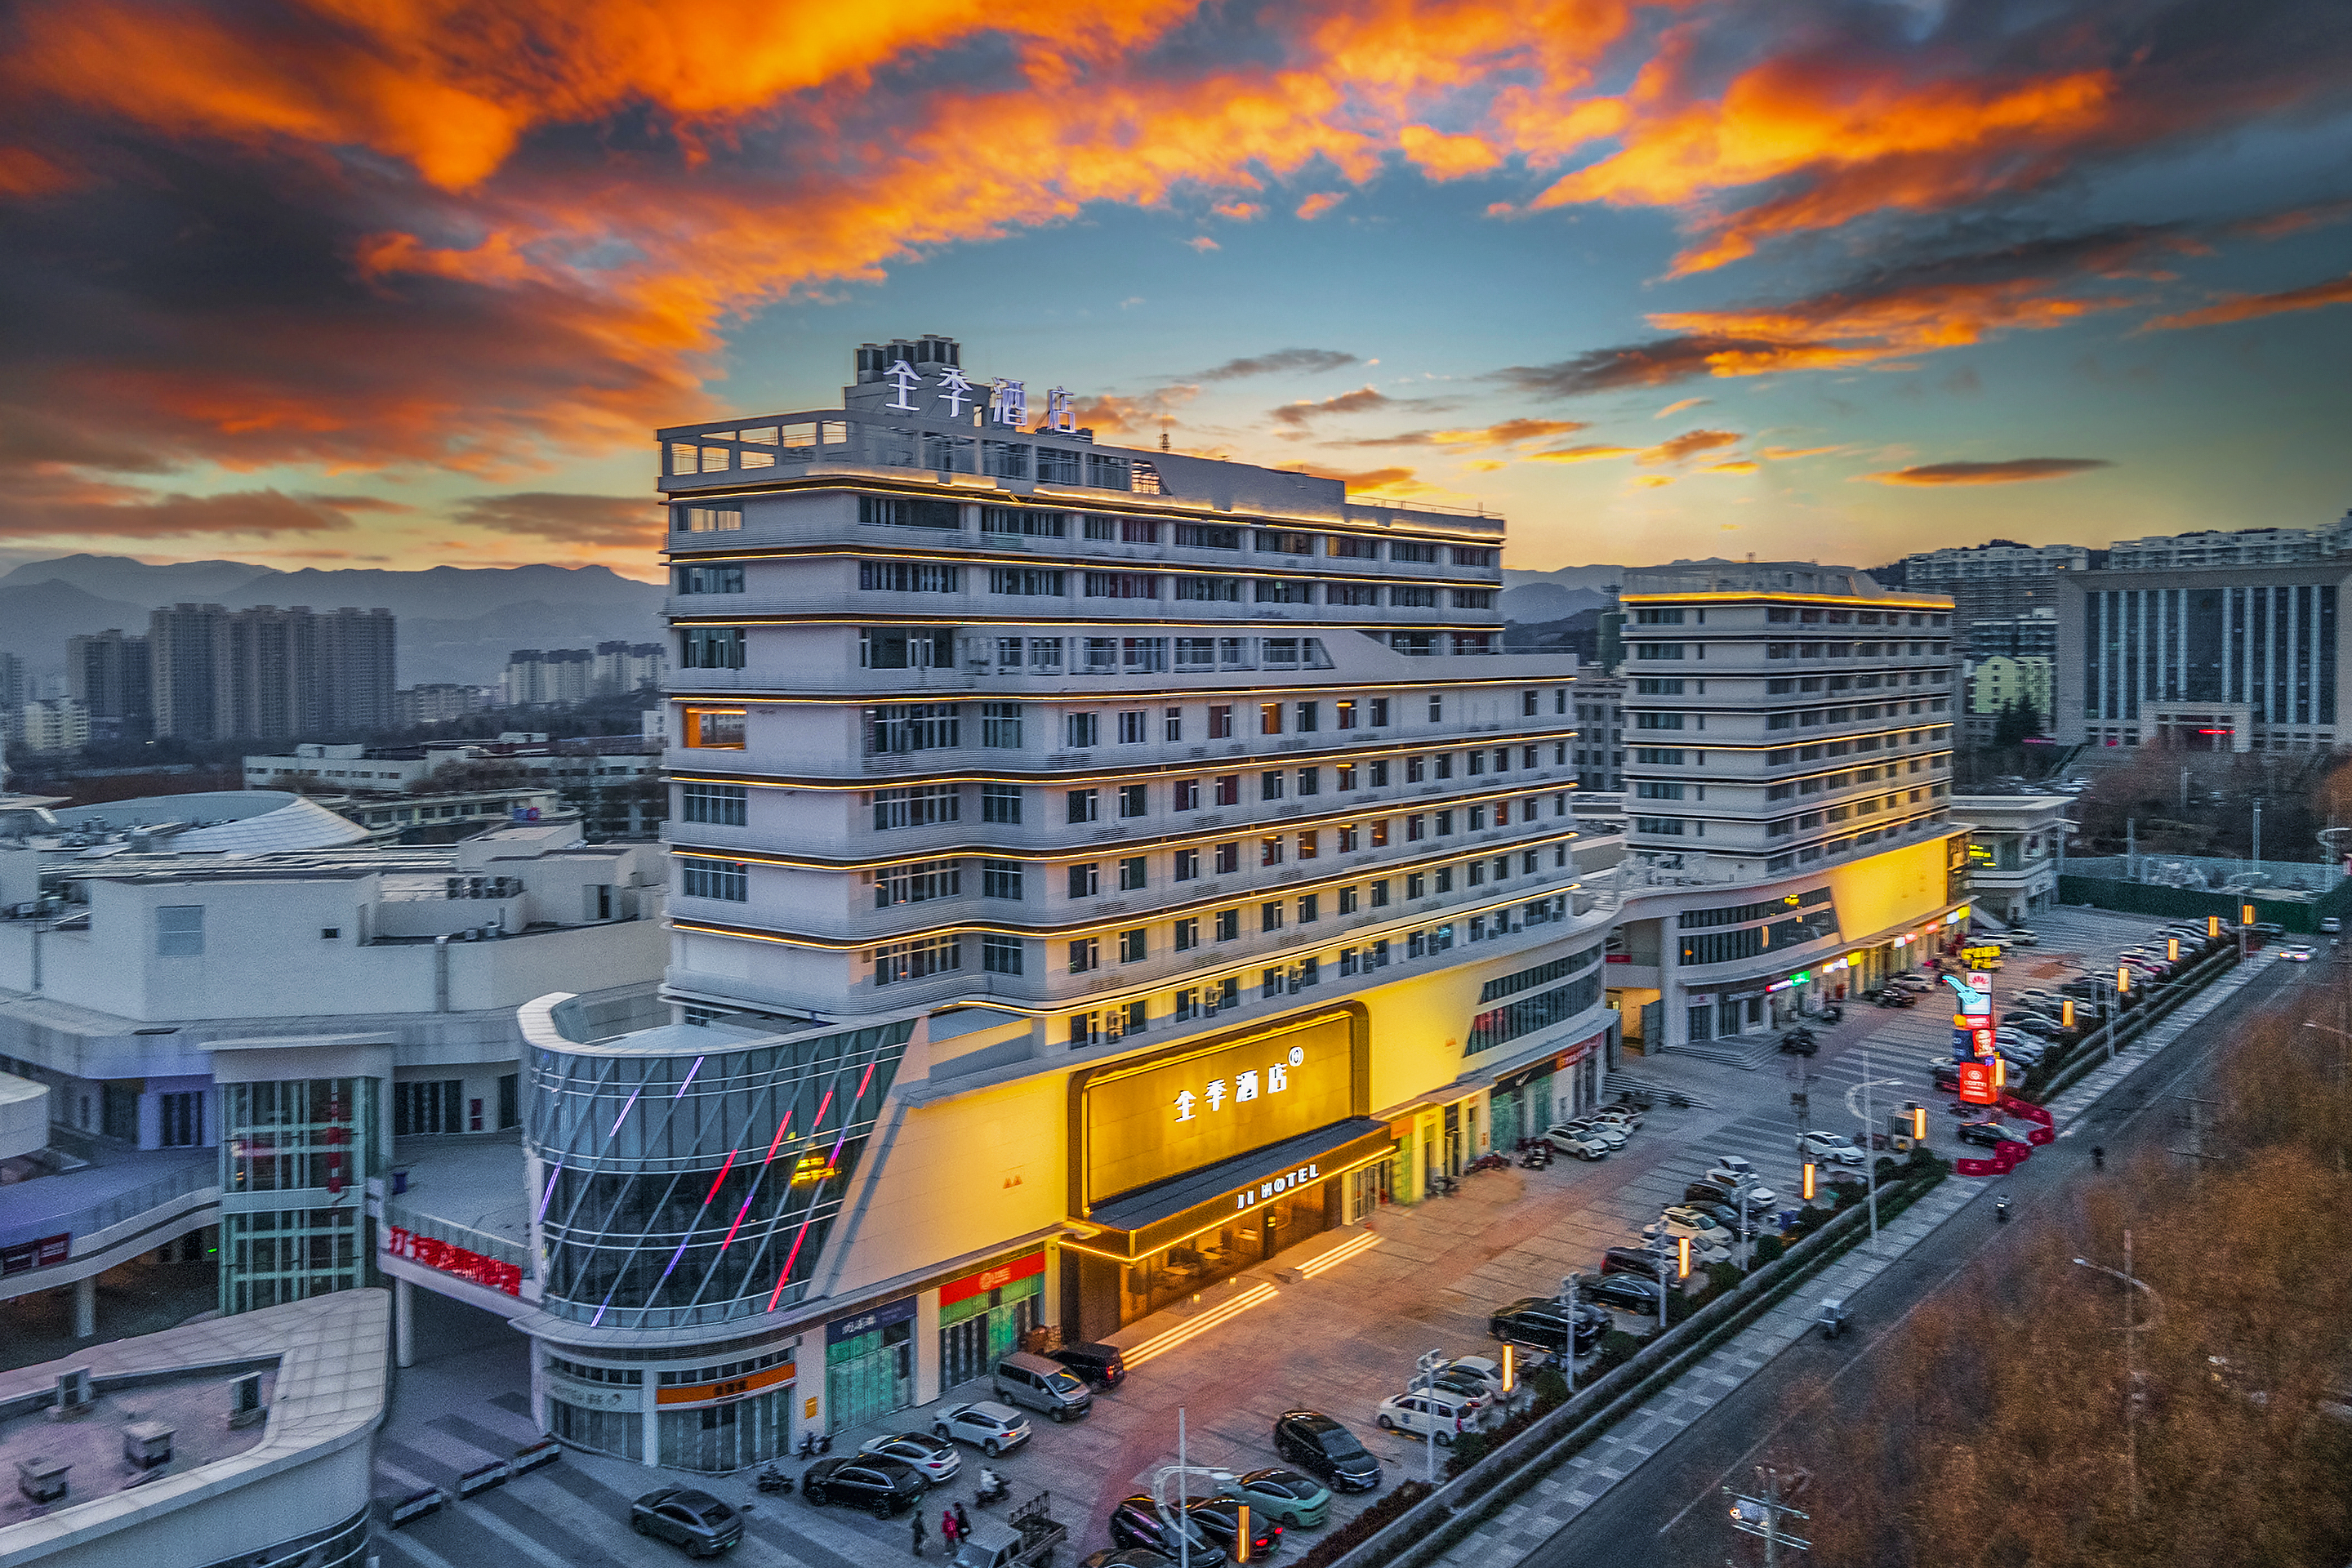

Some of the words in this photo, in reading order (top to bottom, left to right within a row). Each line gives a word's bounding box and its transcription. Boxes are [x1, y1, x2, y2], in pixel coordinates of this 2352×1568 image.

[884, 360, 1076, 434] 全季酒店
[1174, 1063, 1288, 1123] 全季酒店
[1237, 1191, 1254, 1209] JI
[1261, 1164, 1320, 1199] HOTEL
